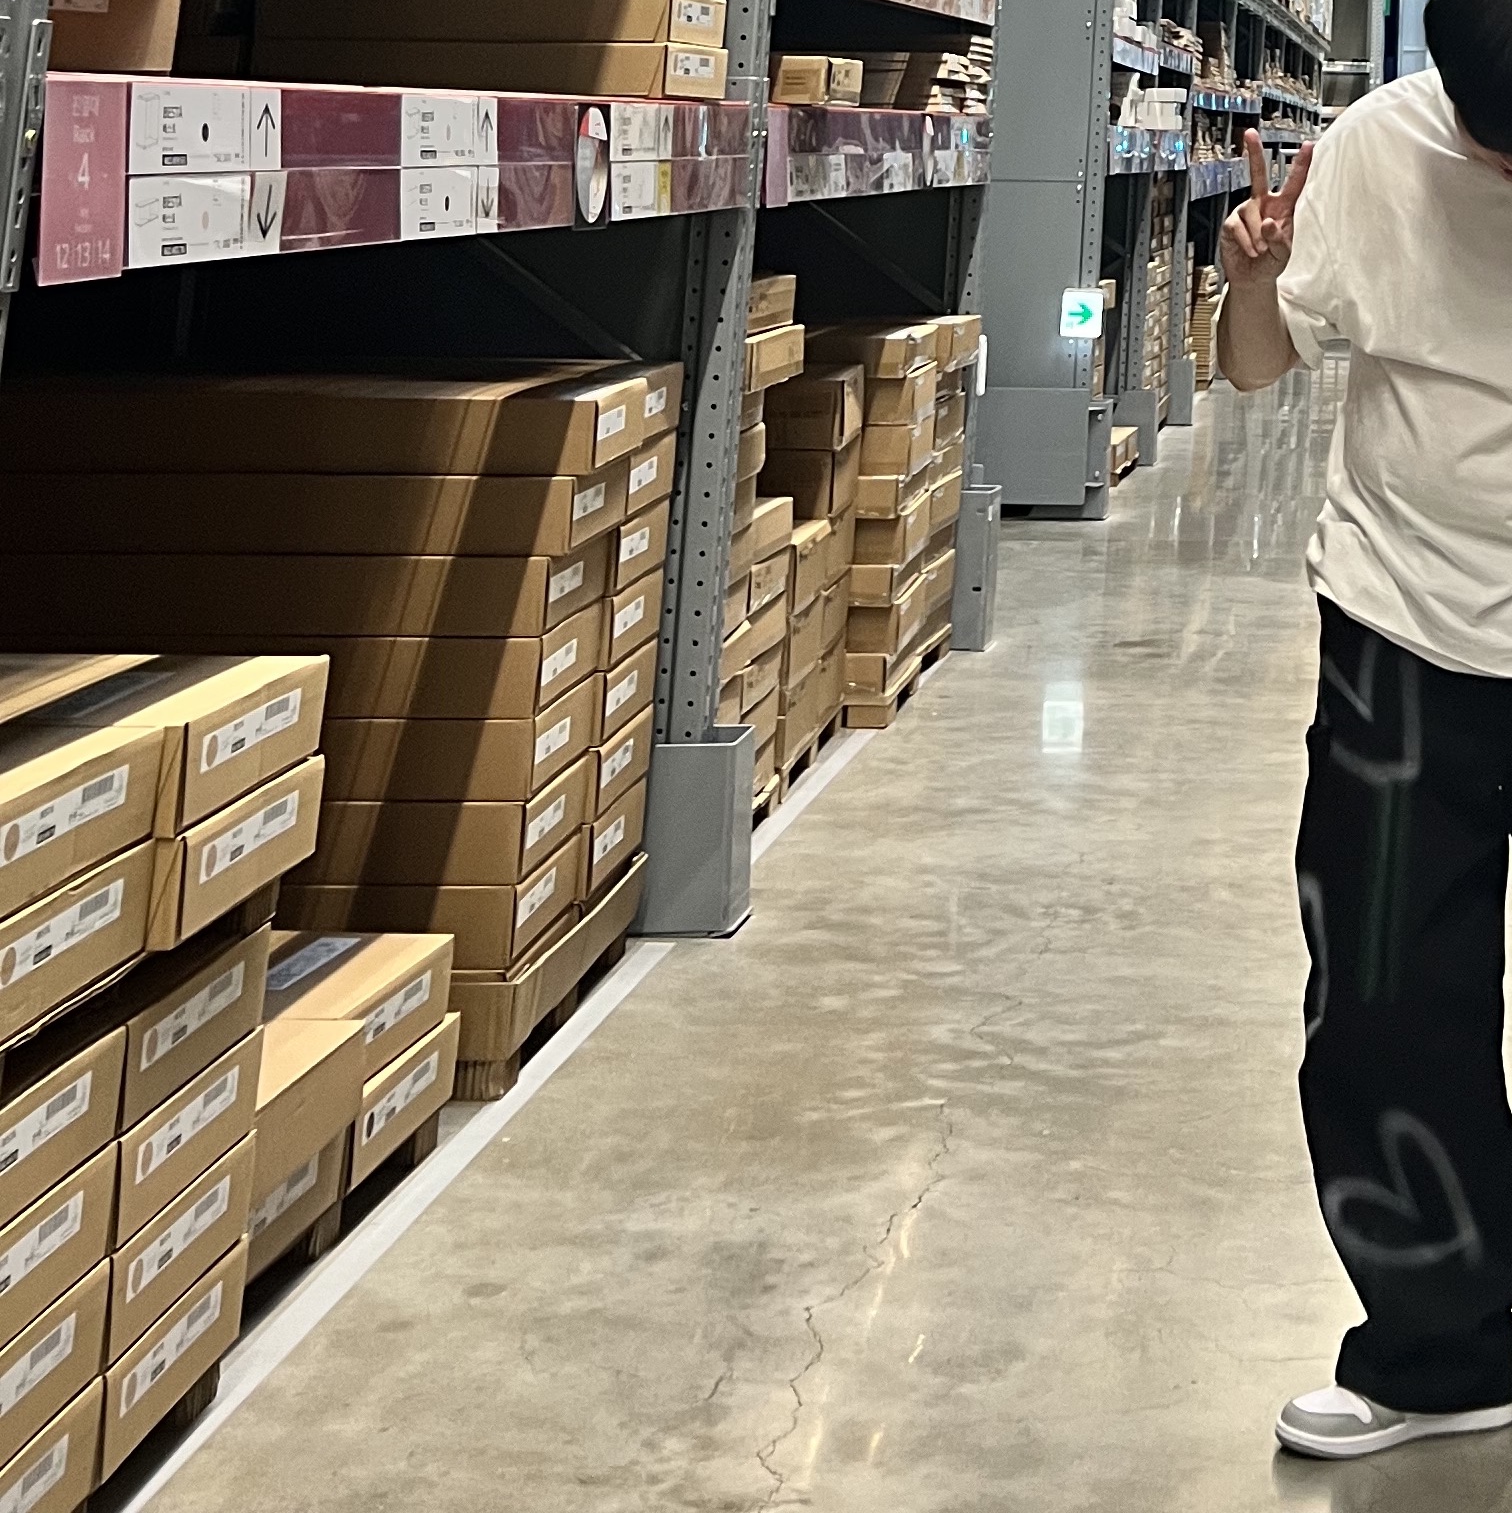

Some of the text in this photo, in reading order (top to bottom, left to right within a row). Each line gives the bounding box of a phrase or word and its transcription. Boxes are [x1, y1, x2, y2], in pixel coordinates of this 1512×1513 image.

[77, 151, 90, 191] 4
[56, 240, 111, 269] 12 13 14
